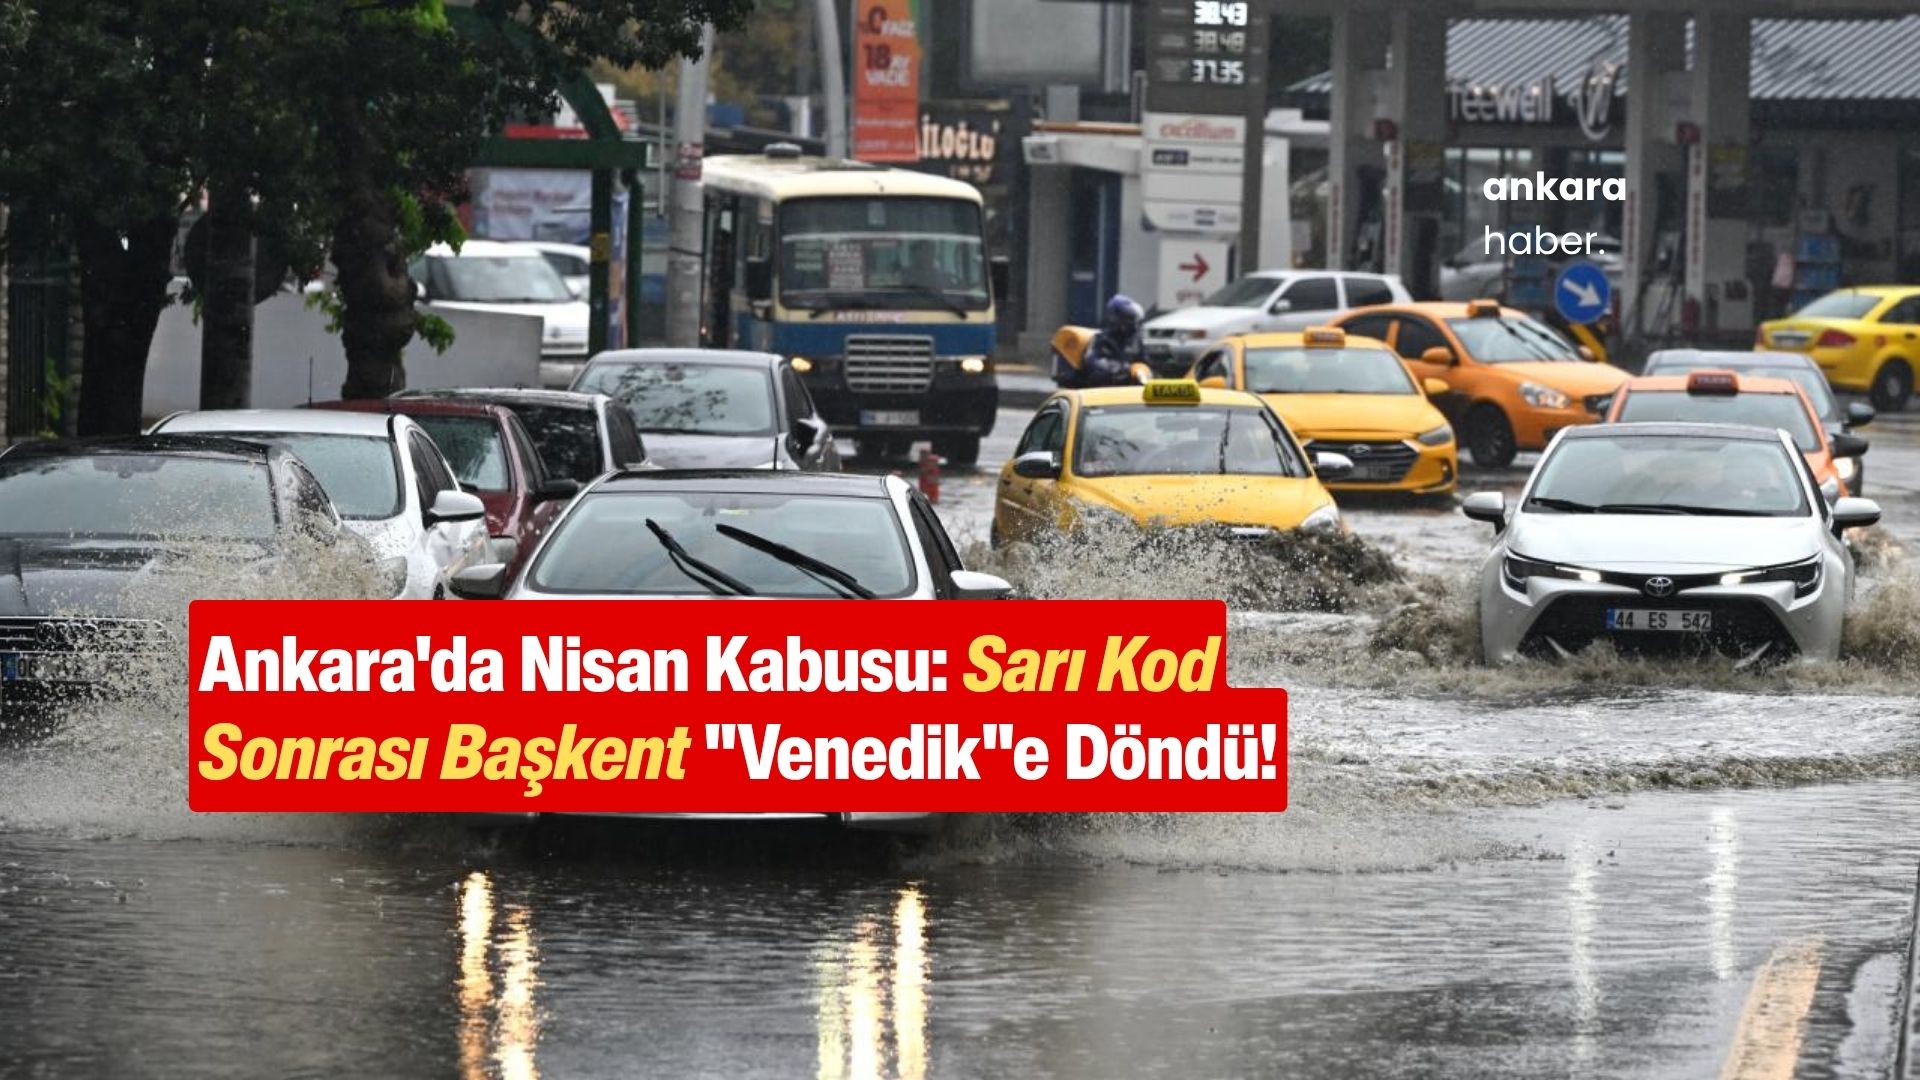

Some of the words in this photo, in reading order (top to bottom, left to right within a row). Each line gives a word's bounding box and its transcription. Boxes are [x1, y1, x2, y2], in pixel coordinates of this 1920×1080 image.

[864, 43, 890, 71] 18
[1615, 611, 1635, 628] 44
[1647, 611, 1669, 629] ES
[1681, 612, 1712, 631] 542
